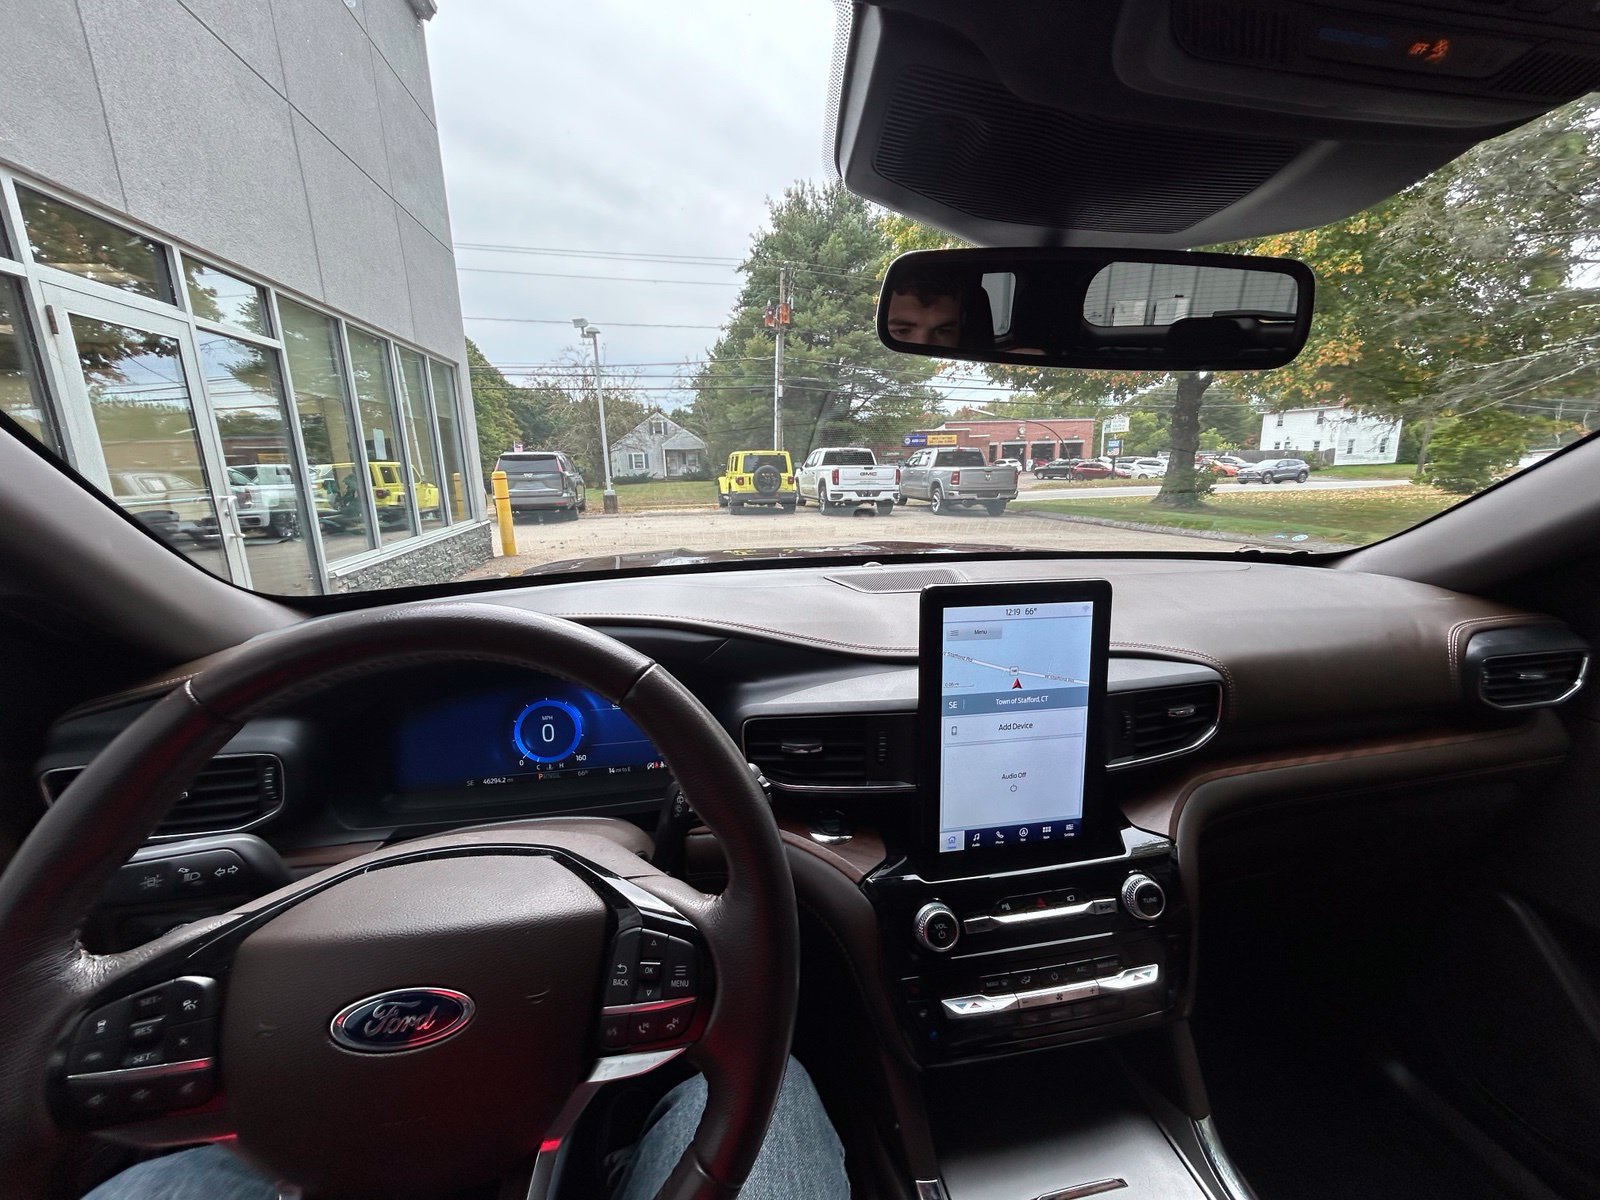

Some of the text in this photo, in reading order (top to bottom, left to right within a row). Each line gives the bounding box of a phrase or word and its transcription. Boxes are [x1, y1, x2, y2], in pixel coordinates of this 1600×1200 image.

[1006, 607, 1037, 616] 12:19 66°
[948, 701, 958, 709] SE
[1013, 722, 1033, 730] Device
[542, 723, 555, 742] 0
[1018, 771, 1026, 779] Off
[364, 1001, 438, 1037] Ford
